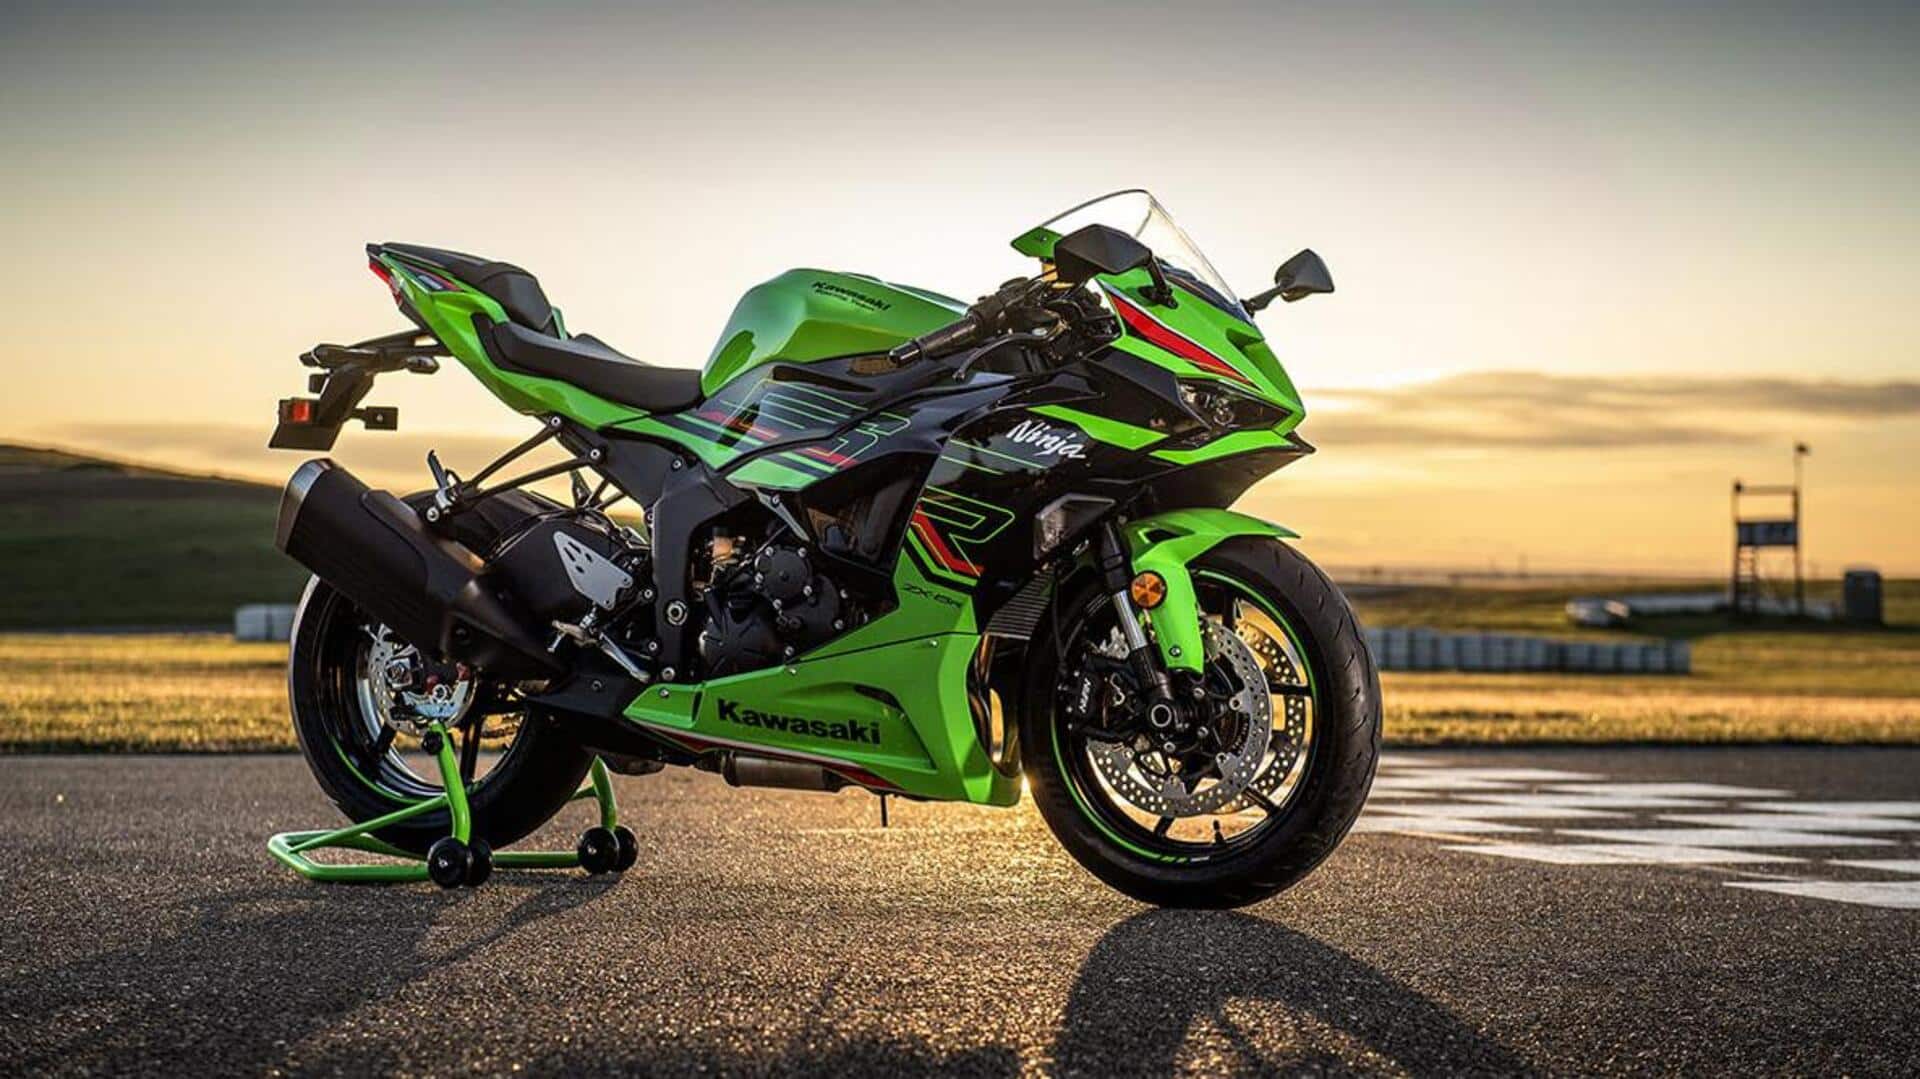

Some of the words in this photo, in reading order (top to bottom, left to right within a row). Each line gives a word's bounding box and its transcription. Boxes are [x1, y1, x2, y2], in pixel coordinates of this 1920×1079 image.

[812, 281, 891, 311] Kawasaki
[1006, 419, 1087, 459] Ninja
[717, 698, 881, 745] Kawasaki
